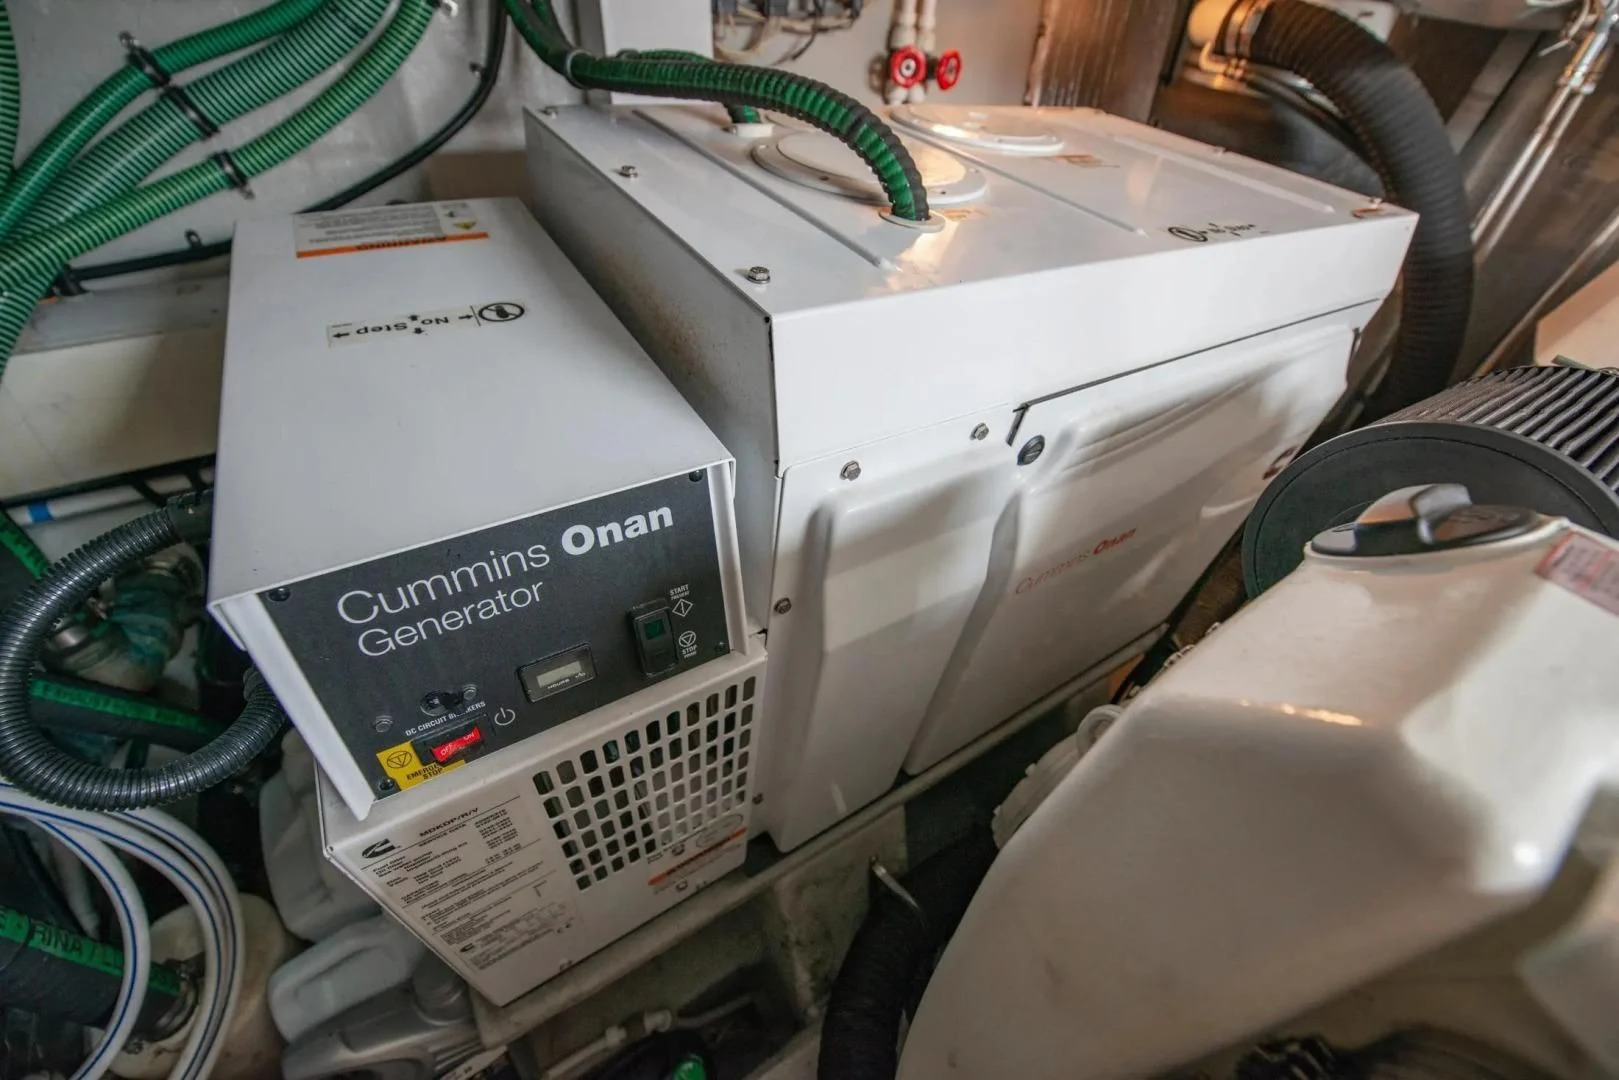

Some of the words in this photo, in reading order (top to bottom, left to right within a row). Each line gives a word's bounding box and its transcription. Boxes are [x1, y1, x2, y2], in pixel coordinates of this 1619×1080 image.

[420, 316, 449, 326] No
[355, 322, 408, 335] Step
[336, 543, 550, 625] Cummins
[561, 505, 674, 556] Onan
[669, 584, 689, 596] START
[357, 580, 544, 657] Generator
[682, 645, 698, 654] STOP
[405, 727, 417, 737] DC
[417, 715, 448, 732] CIRCUIT
[440, 743, 453, 756] OFF
[423, 767, 444, 780] STOP
